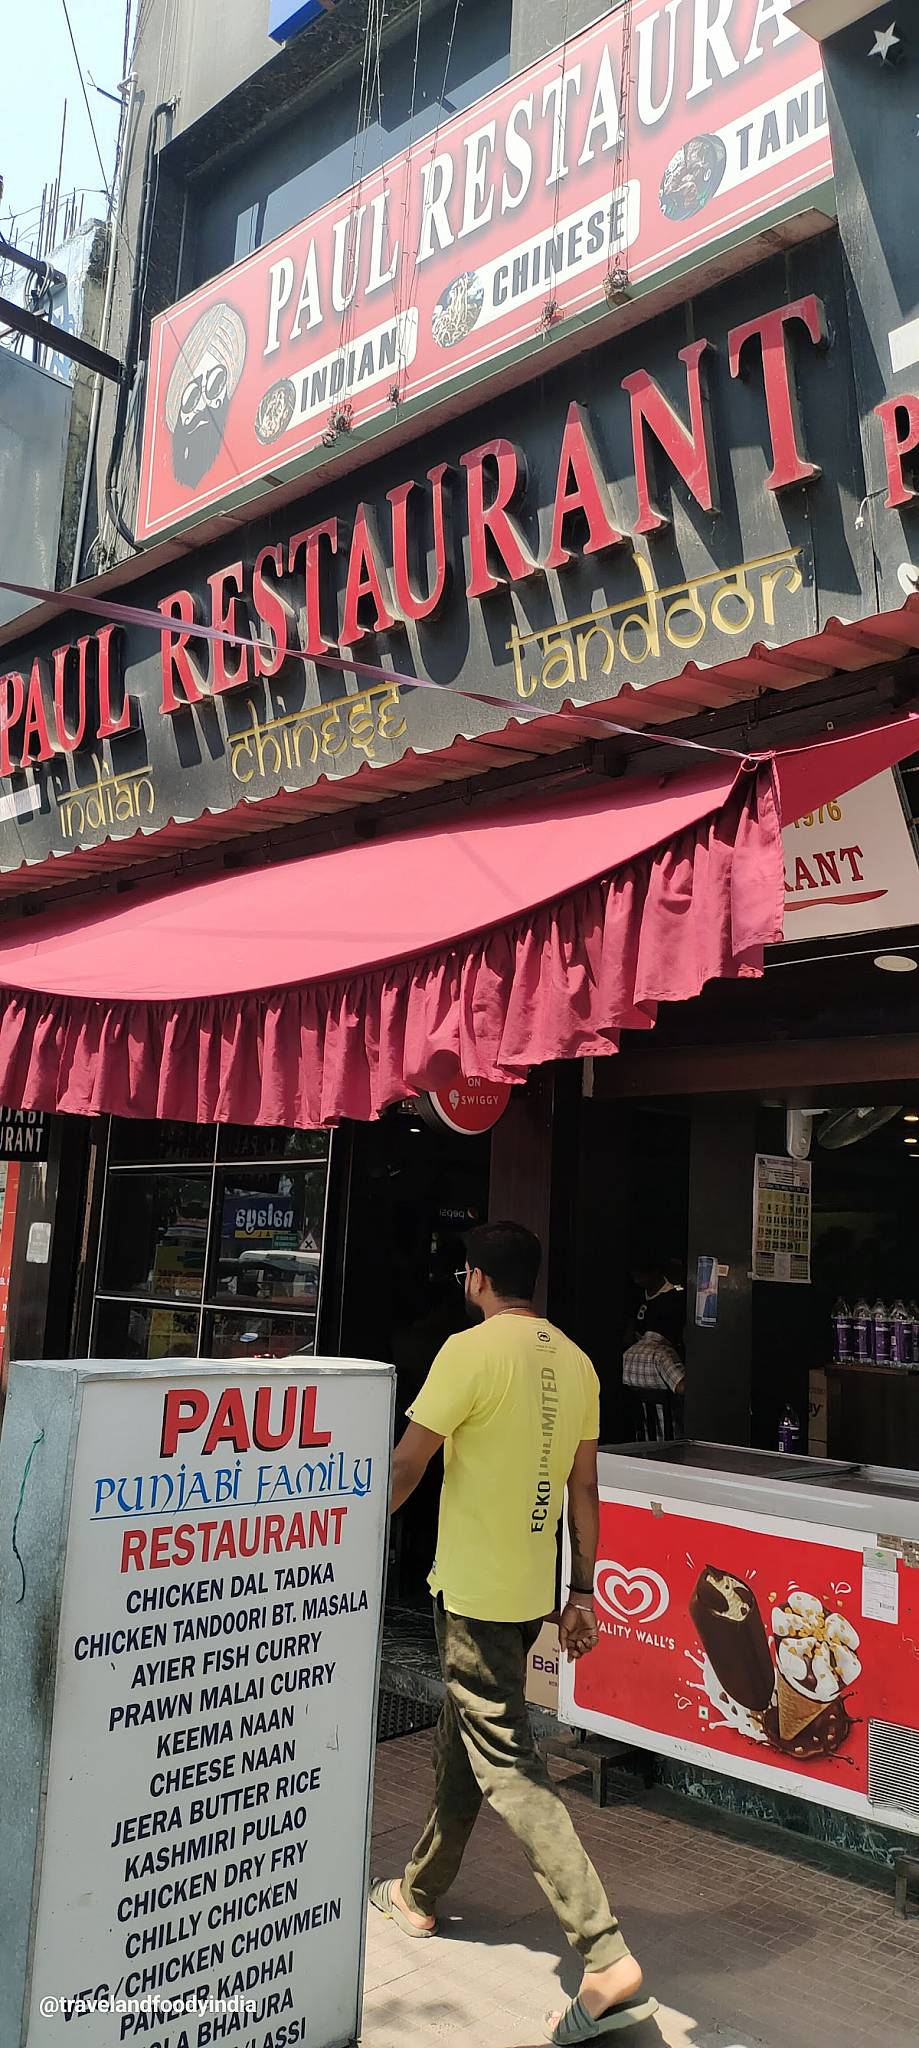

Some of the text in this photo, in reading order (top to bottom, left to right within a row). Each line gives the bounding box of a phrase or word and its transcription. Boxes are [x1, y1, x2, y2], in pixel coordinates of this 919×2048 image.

[263, 188, 400, 356] PAUL
[300, 326, 398, 412] INDIAN
[492, 197, 625, 307] CHINESE
[0, 293, 824, 777] PAUL RESTAURANT
[506, 547, 804, 698] tandoor
[461, 1095, 499, 1105] SWIGGY
[467, 1077, 481, 1087] ON
[159, 1385, 332, 1459] PAUL
[119, 1506, 349, 1574] RESTAURANT
[530, 1480, 551, 1534] ECKO
[126, 1562, 335, 1615] CHICKEN DAL TADKA
[73, 1589, 369, 1661] CHICKEN TANDOORI BT. MASALA
[635, 1629, 676, 1650] WALL'S
[130, 1631, 323, 1689] AYIER FISH CURRY
[108, 1661, 337, 1732] PRAWN MALAI CURRY
[156, 1705, 295, 1759] KEEMA NAAN
[149, 1739, 296, 1798] CHEESE NAAN
[110, 1767, 322, 1848] JEERA BUTTER RICE
[124, 1806, 308, 1883] KASHMIRI PULAO
[117, 1839, 309, 1923] CHICKEN DRY FRY
[125, 1878, 299, 1960] CHILLY CHICKEN
[231, 1897, 342, 1959] CHOWMEIN
[216, 1951, 295, 2001] KADHAI
